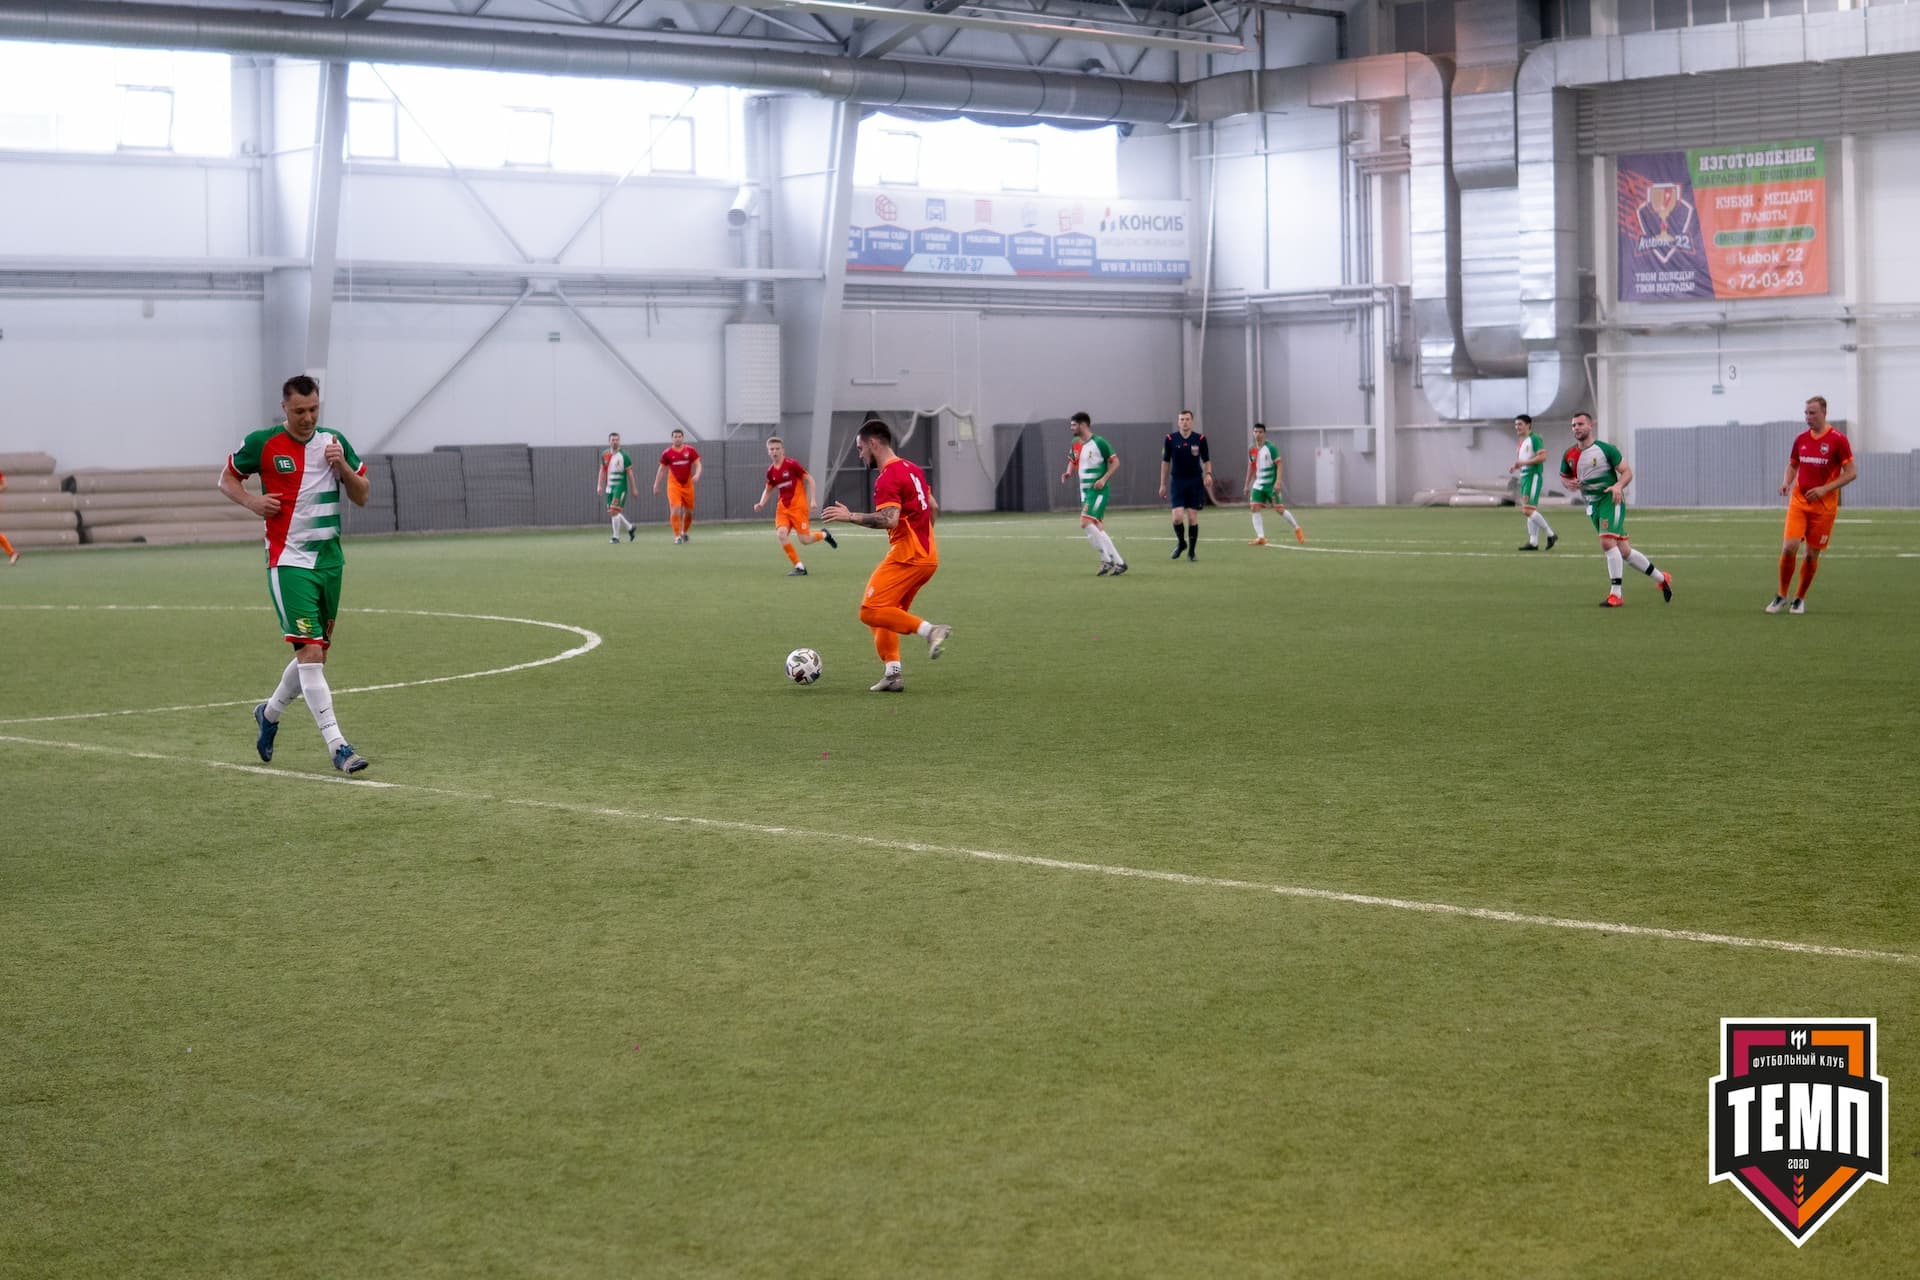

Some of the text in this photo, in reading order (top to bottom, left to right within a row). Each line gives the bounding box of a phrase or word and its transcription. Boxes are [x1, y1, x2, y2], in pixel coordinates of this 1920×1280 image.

[1699, 147, 1816, 171] ИЗГОТОВЛЕНИЕ
[1715, 189, 1814, 209] КУБКИ МЕДАЛИ
[1119, 215, 1184, 232] КОНСИБ
[937, 257, 983, 272] 73-00-37
[1739, 270, 1804, 289] 72-03-23
[1729, 364, 1737, 381] 3
